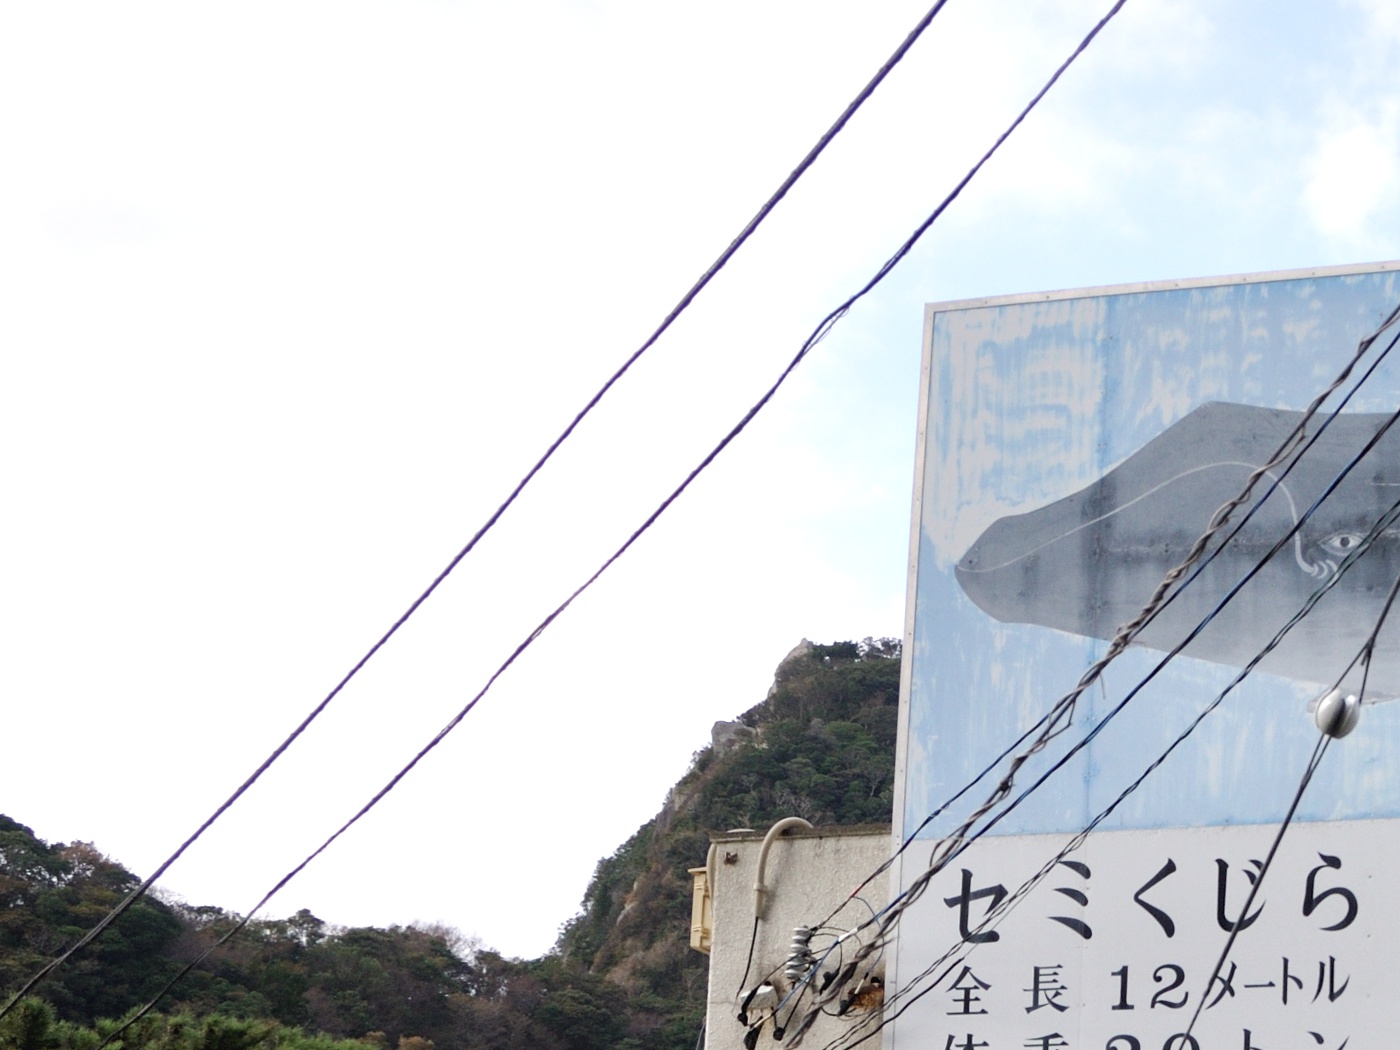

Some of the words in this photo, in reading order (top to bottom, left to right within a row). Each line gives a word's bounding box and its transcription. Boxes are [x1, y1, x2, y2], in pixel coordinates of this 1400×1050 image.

[943, 851, 1359, 944] セミくじら
